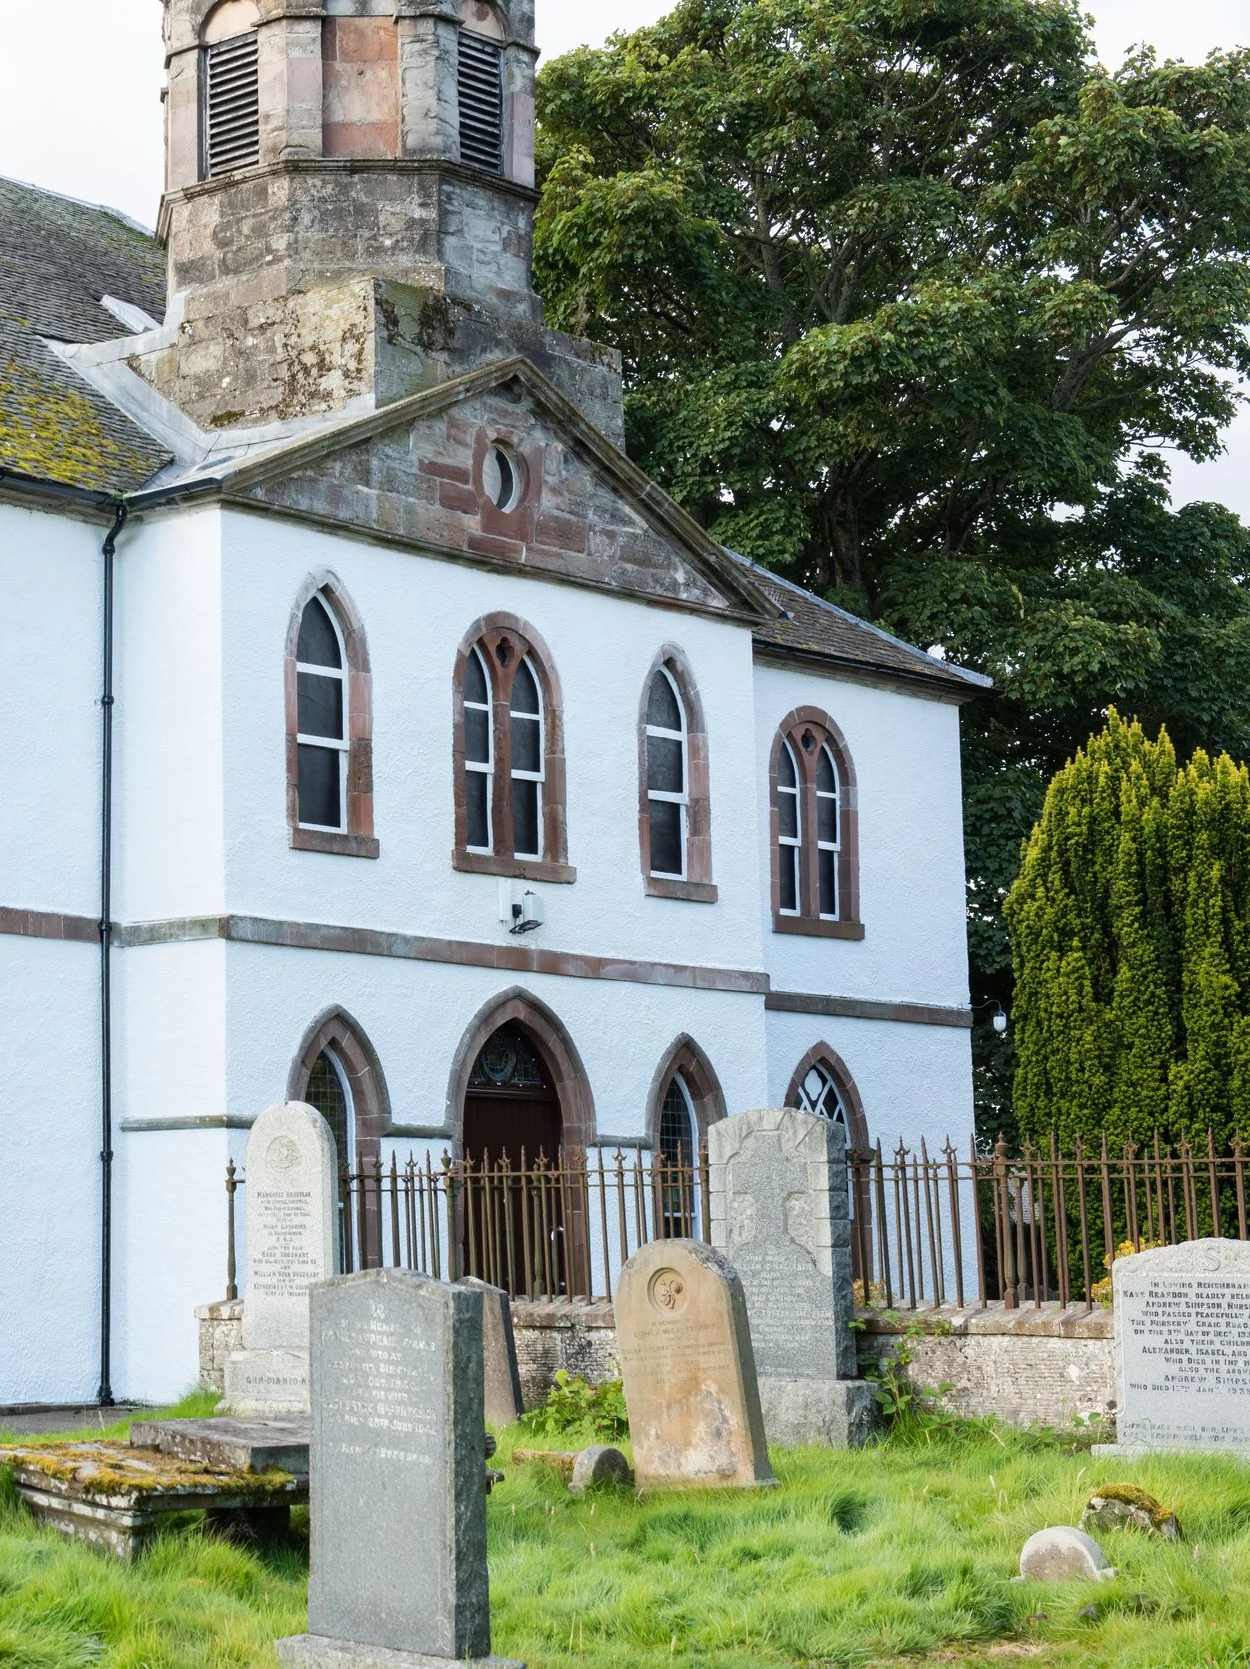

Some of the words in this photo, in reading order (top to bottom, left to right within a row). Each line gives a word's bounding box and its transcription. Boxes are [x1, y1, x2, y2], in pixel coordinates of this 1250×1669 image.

[1162, 1281, 1193, 1289] LOVING
[1185, 1301, 1225, 1311] SIMPSON,
[1227, 1302, 1250, 1310] NURS
[1162, 1310, 1192, 1318] PASSED
[1195, 1311, 1244, 1319] PEACEFULLY
[1187, 1357, 1206, 1365] DIED
[1203, 1367, 1221, 1375] THE
[1226, 1368, 1250, 1376] ABOV
[1164, 1375, 1207, 1383] ANDREW
[1215, 1376, 1250, 1386] SIMPS
